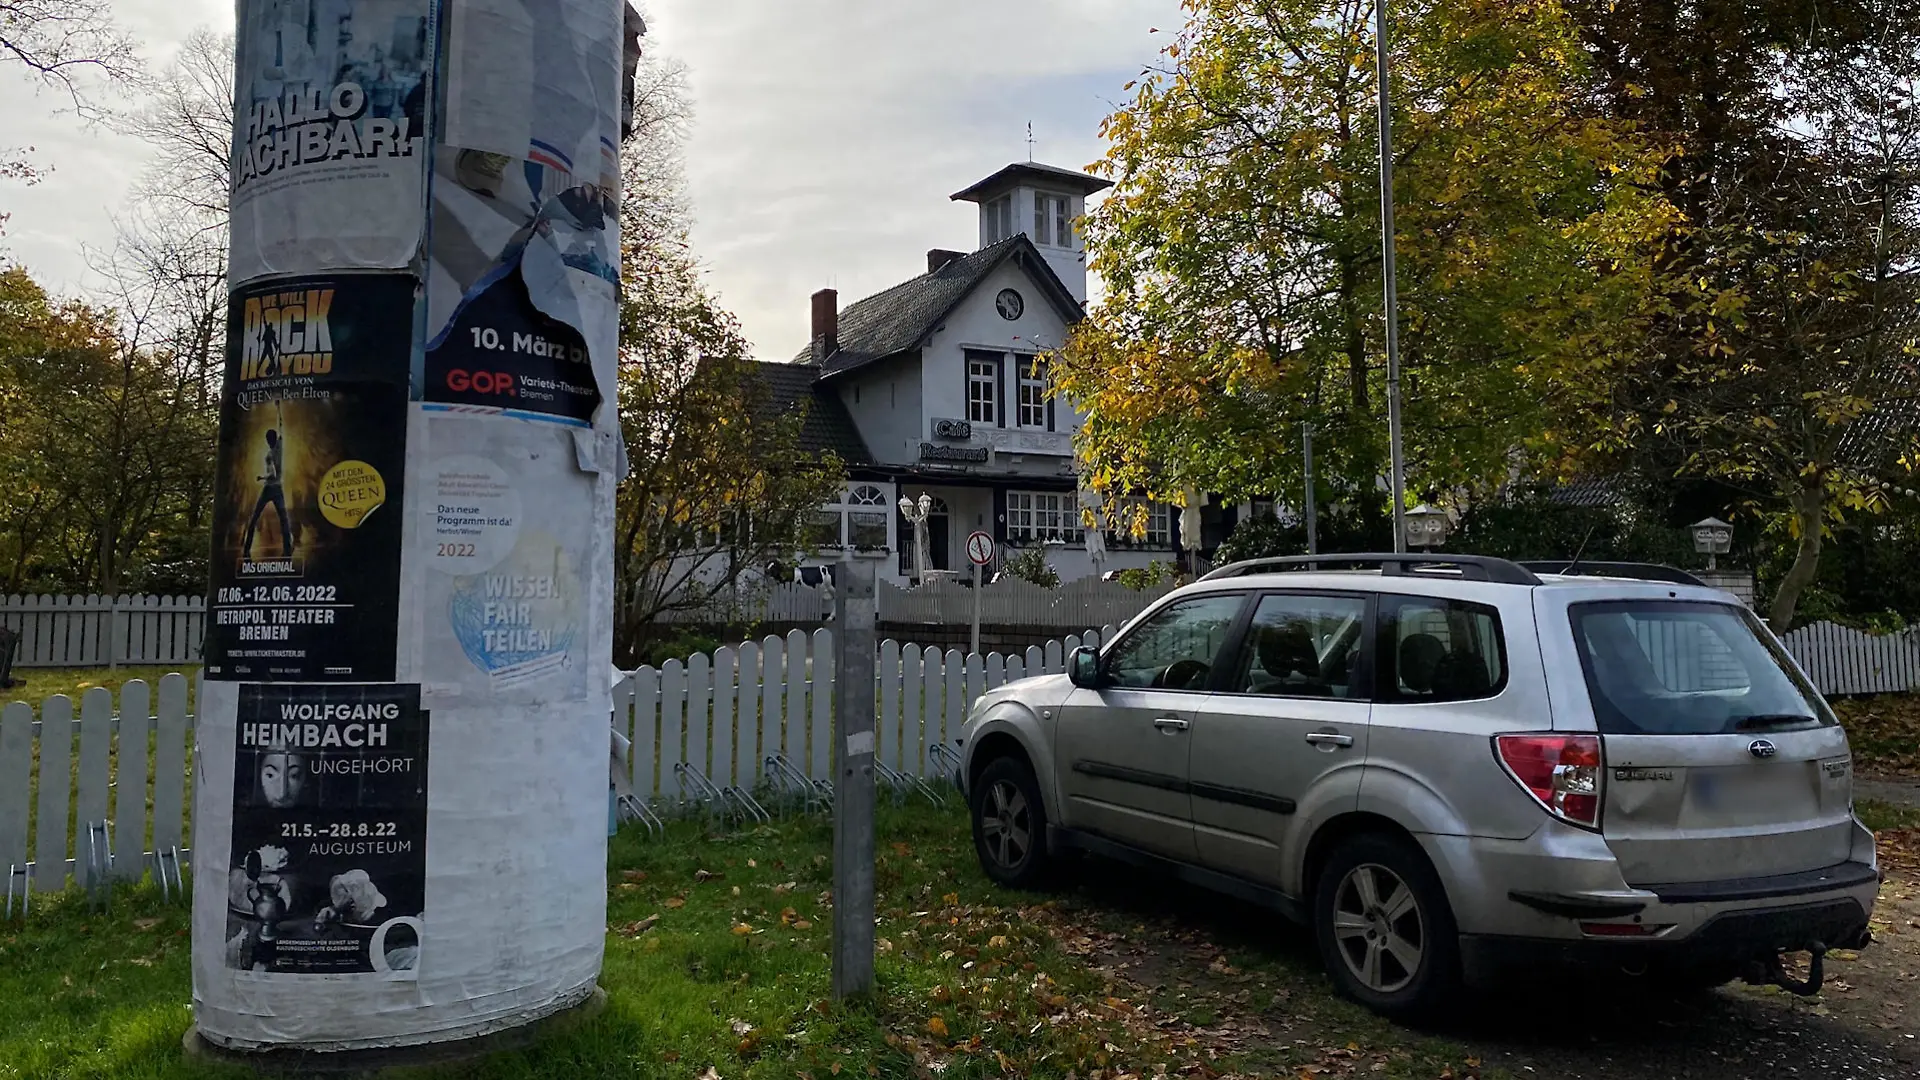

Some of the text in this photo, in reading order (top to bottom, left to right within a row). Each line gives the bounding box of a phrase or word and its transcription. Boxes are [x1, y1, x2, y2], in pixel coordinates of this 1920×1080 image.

[247, 81, 368, 143] HALLO
[279, 290, 306, 306] WILL
[240, 289, 335, 381] ROCK
[470, 326, 505, 351] 10.
[512, 331, 565, 360] März
[279, 353, 333, 376] YOU
[246, 377, 314, 390] DAS MUSICAL VON
[446, 368, 516, 397] GOP.
[237, 386, 330, 411] QUEEN Ben Elton
[520, 388, 554, 401] Bremen
[333, 468, 363, 479] MIT DEN
[325, 481, 335, 490] 24
[322, 486, 380, 510] QUEEN
[437, 504, 455, 514] Das
[437, 515, 513, 527] Programm ist da!
[436, 543, 475, 557] 2022
[242, 561, 296, 574] DAS ORIGINAL
[484, 574, 560, 600] WISSEN
[216, 609, 336, 625] METROPOL THEATER
[483, 602, 532, 626] FAIR
[239, 625, 290, 640] BREMEN
[482, 629, 551, 652] TEILEN
[280, 703, 400, 720] WOLFGANG
[242, 722, 388, 748] HEIMBACH
[311, 757, 414, 775] UNGEHÖRT
[309, 841, 412, 855] AUGUSTEUM
